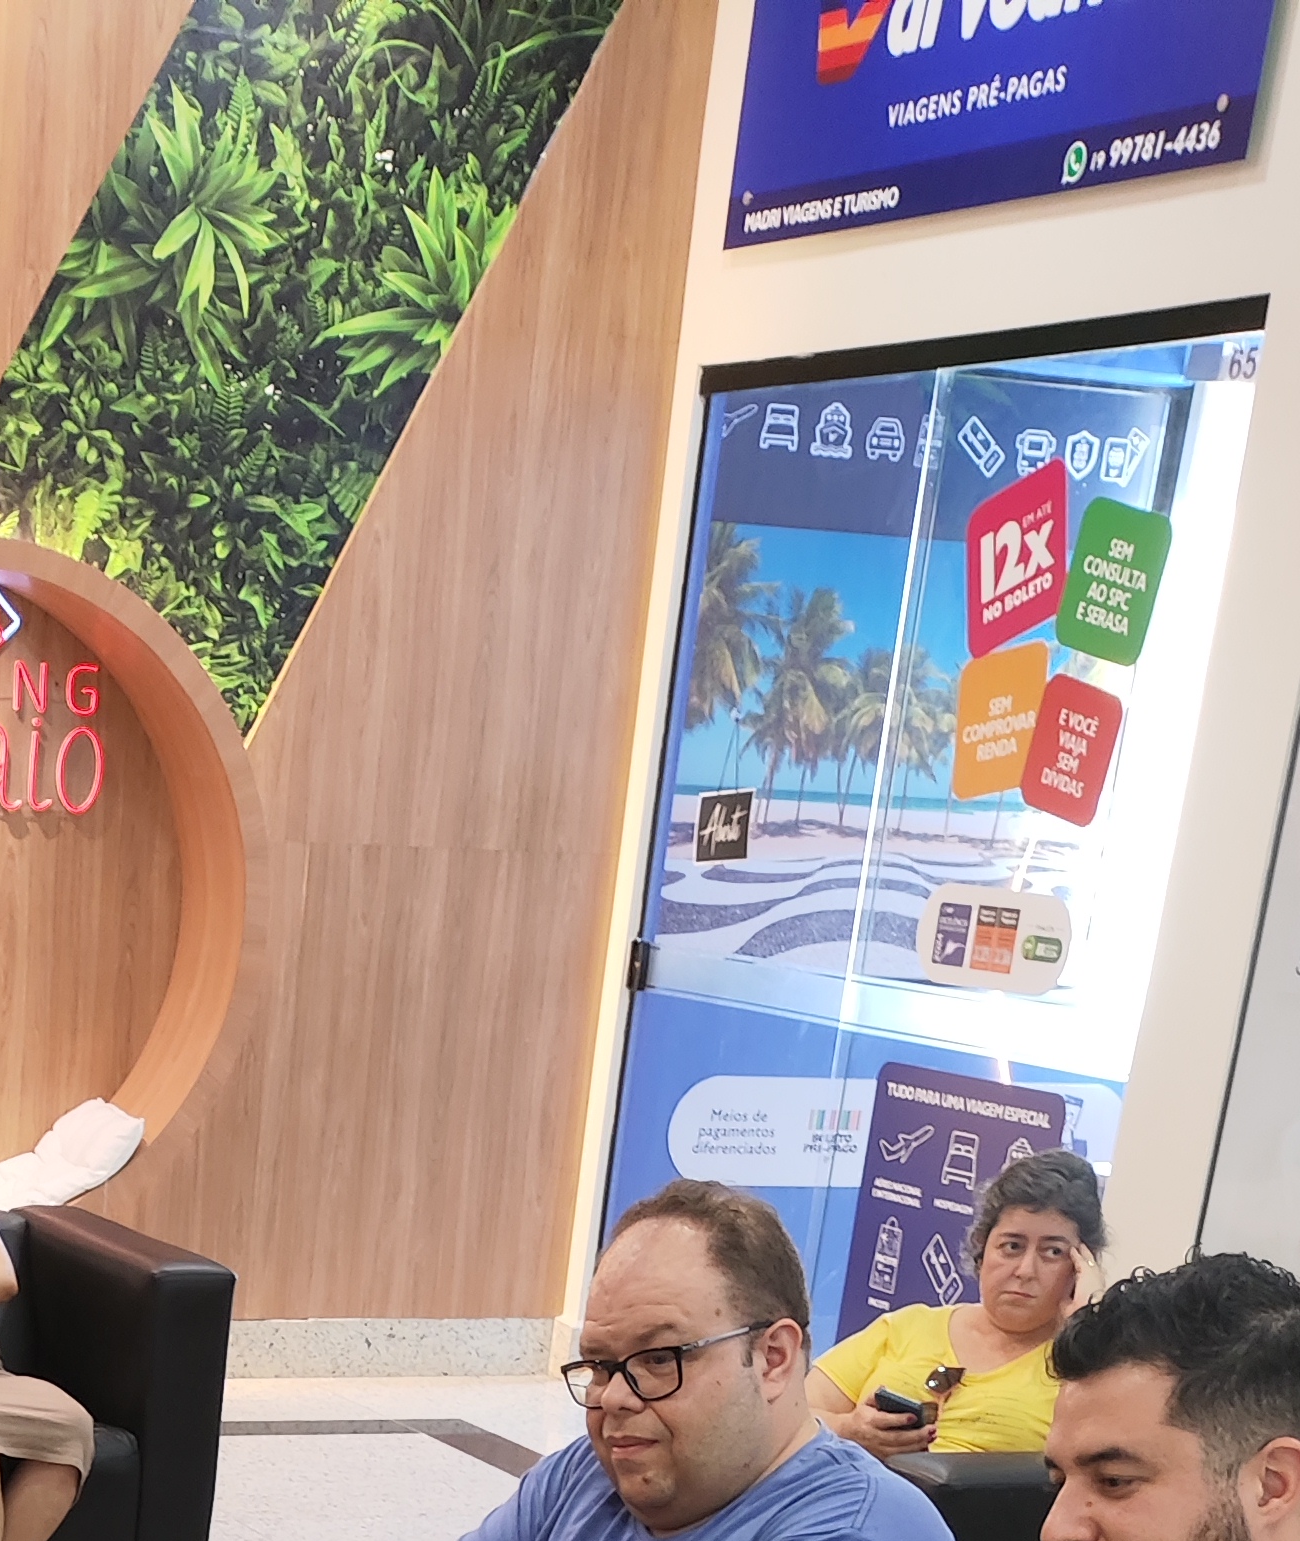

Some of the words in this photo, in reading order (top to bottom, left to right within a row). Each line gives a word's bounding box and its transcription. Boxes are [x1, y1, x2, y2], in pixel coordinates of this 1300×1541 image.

[887, 89, 963, 129] VIAGENS
[966, 65, 1067, 112] PRÉ-PAGAS
[1090, 149, 1107, 171] 19
[1109, 119, 1221, 168] 99781-4436
[743, 211, 781, 233] MADRI
[782, 198, 832, 225] VIAGENS
[832, 196, 842, 218] E
[843, 186, 900, 215] TURISMO
[1228, 346, 1259, 379] 65
[1022, 511, 1035, 529] EM
[1108, 537, 1135, 562] SEM
[1083, 555, 1147, 592] CONSULTA
[982, 601, 1003, 625] NO
[1004, 572, 1053, 613] BOLETO
[1086, 581, 1107, 602] AO
[1107, 588, 1132, 611] SPC
[1075, 601, 1087, 620] E
[1086, 604, 1129, 636] SERASA
[988, 694, 1013, 717] SEM
[962, 710, 1037, 744] COMPROVAR
[1058, 708, 1068, 726] E
[1068, 716, 1100, 738] VOCÊ
[976, 737, 1018, 762] RENDA
[1058, 729, 1088, 757] VIAJA
[1056, 752, 1080, 774] SEM
[1040, 766, 1085, 799] DÍVIDAS
[710, 1108, 748, 1122] Meios
[753, 1108, 769, 1122] de
[886, 1081, 915, 1101] TUDO
[914, 1087, 941, 1107] PARA
[941, 1093, 965, 1112] UMA
[965, 1097, 1004, 1119] VIAGEM
[1004, 1105, 1052, 1129] ESPECIAL
[691, 1141, 777, 1156] diferenciados
[698, 1127, 775, 1144] pagamentos
